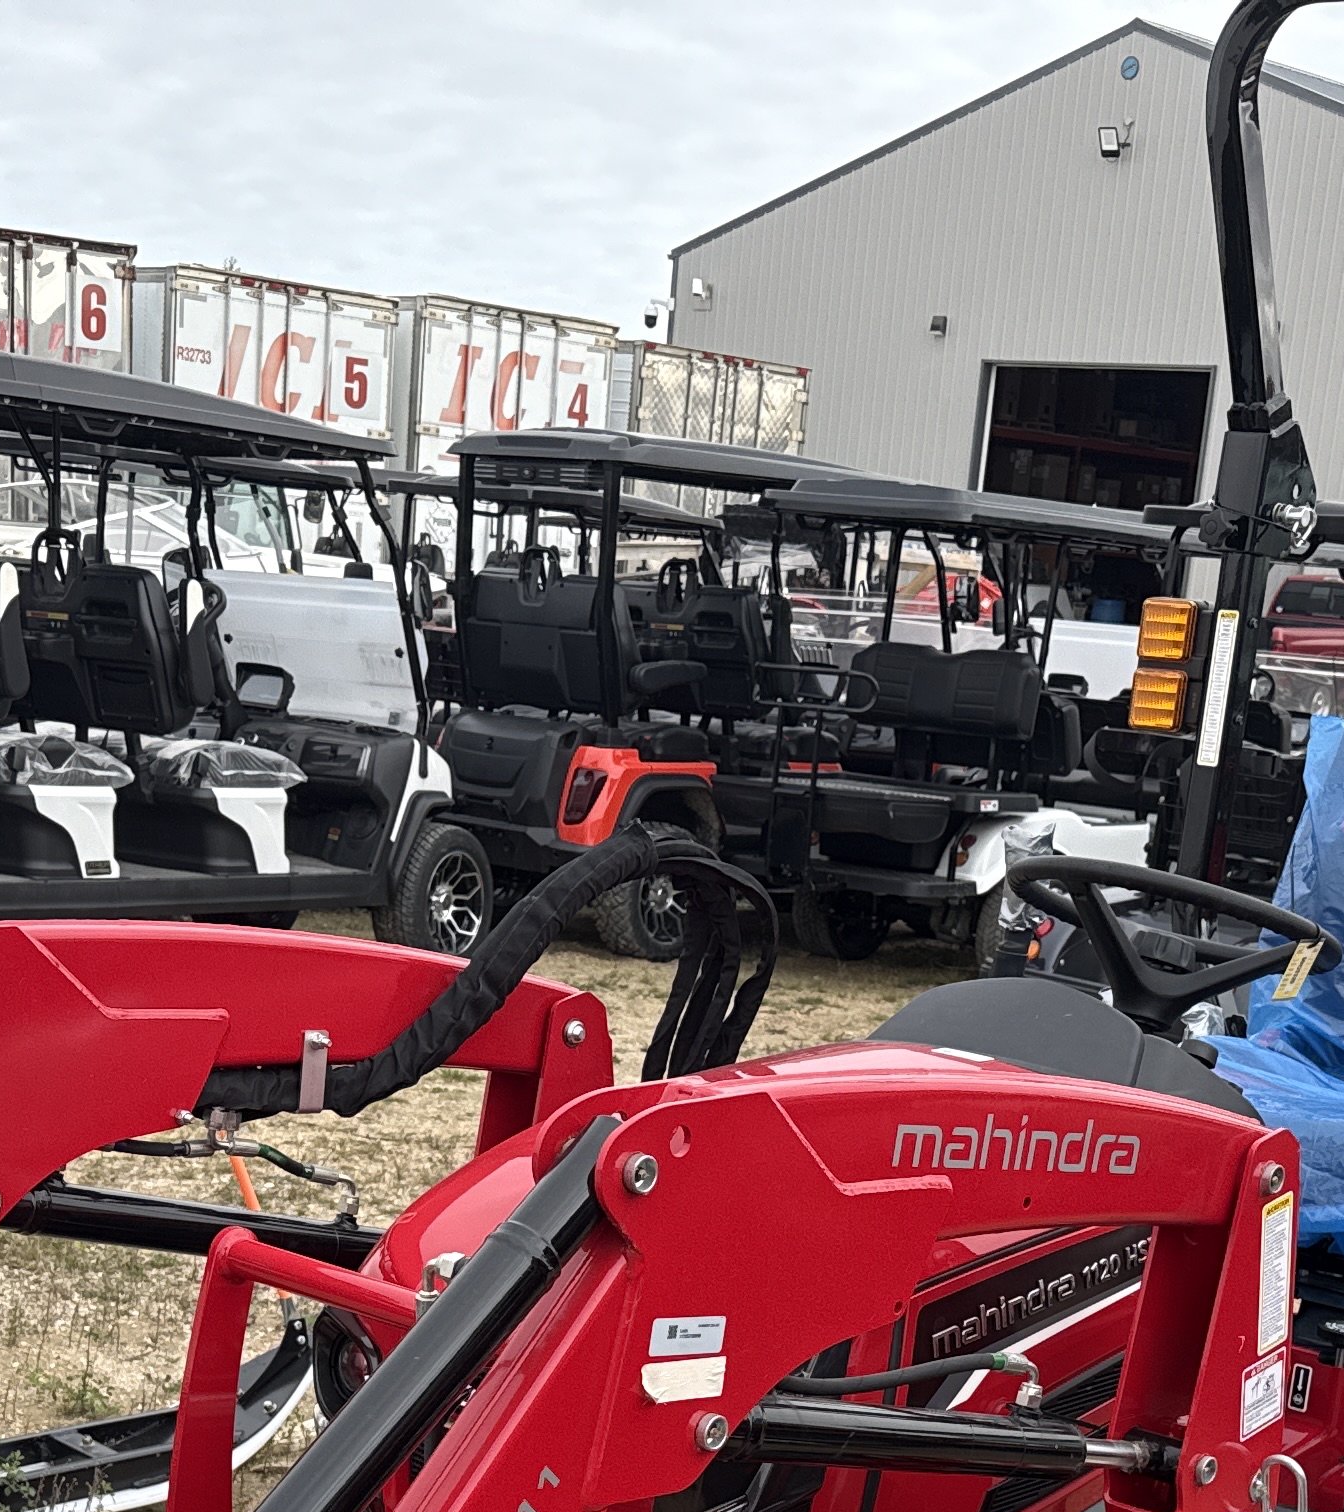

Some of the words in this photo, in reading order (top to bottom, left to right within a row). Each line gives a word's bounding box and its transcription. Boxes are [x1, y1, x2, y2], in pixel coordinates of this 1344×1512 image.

[81, 284, 107, 341] 6
[176, 346, 212, 365] R32733
[344, 356, 369, 409] 5
[566, 383, 589, 427] 4
[891, 1114, 1141, 1175] mahindra
[931, 1273, 1077, 1359] mahindra
[1081, 1253, 1123, 1290] 1120
[1125, 1237, 1153, 1271] HS
